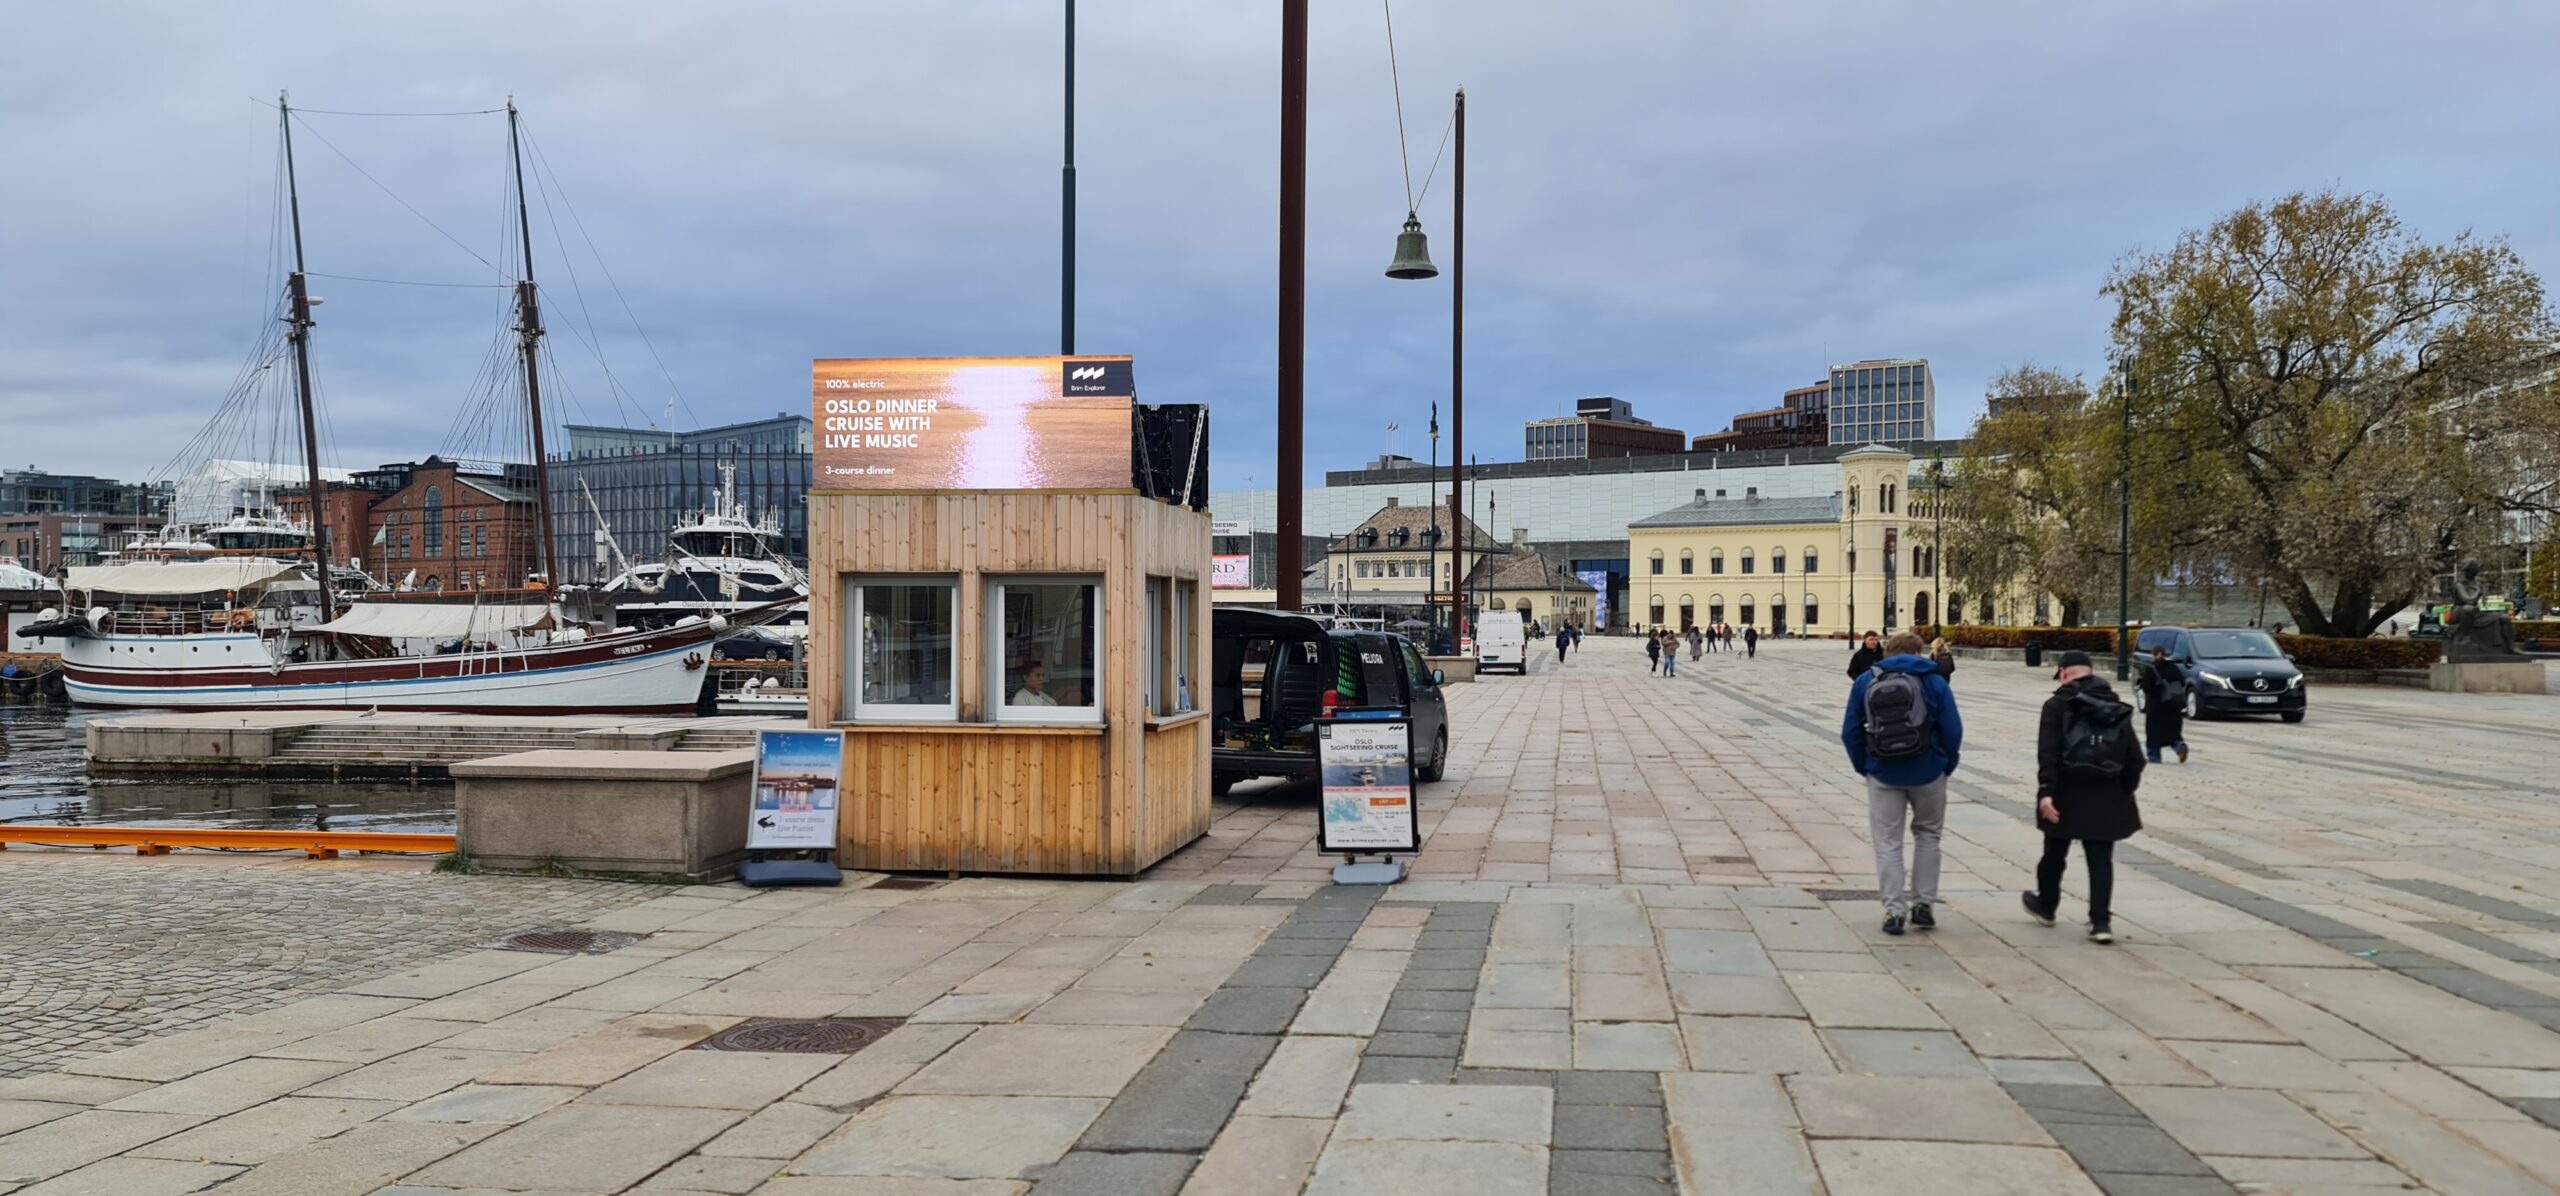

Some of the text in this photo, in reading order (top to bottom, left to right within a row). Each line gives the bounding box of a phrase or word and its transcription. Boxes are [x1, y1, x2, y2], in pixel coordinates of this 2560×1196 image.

[826, 379, 885, 389] 100% electric
[825, 399, 937, 413] OSLO DINNER
[825, 416, 931, 431] CRUISE WITH
[825, 434, 919, 448] LIVE MUSIC
[825, 465, 896, 475] 3-course dinner
